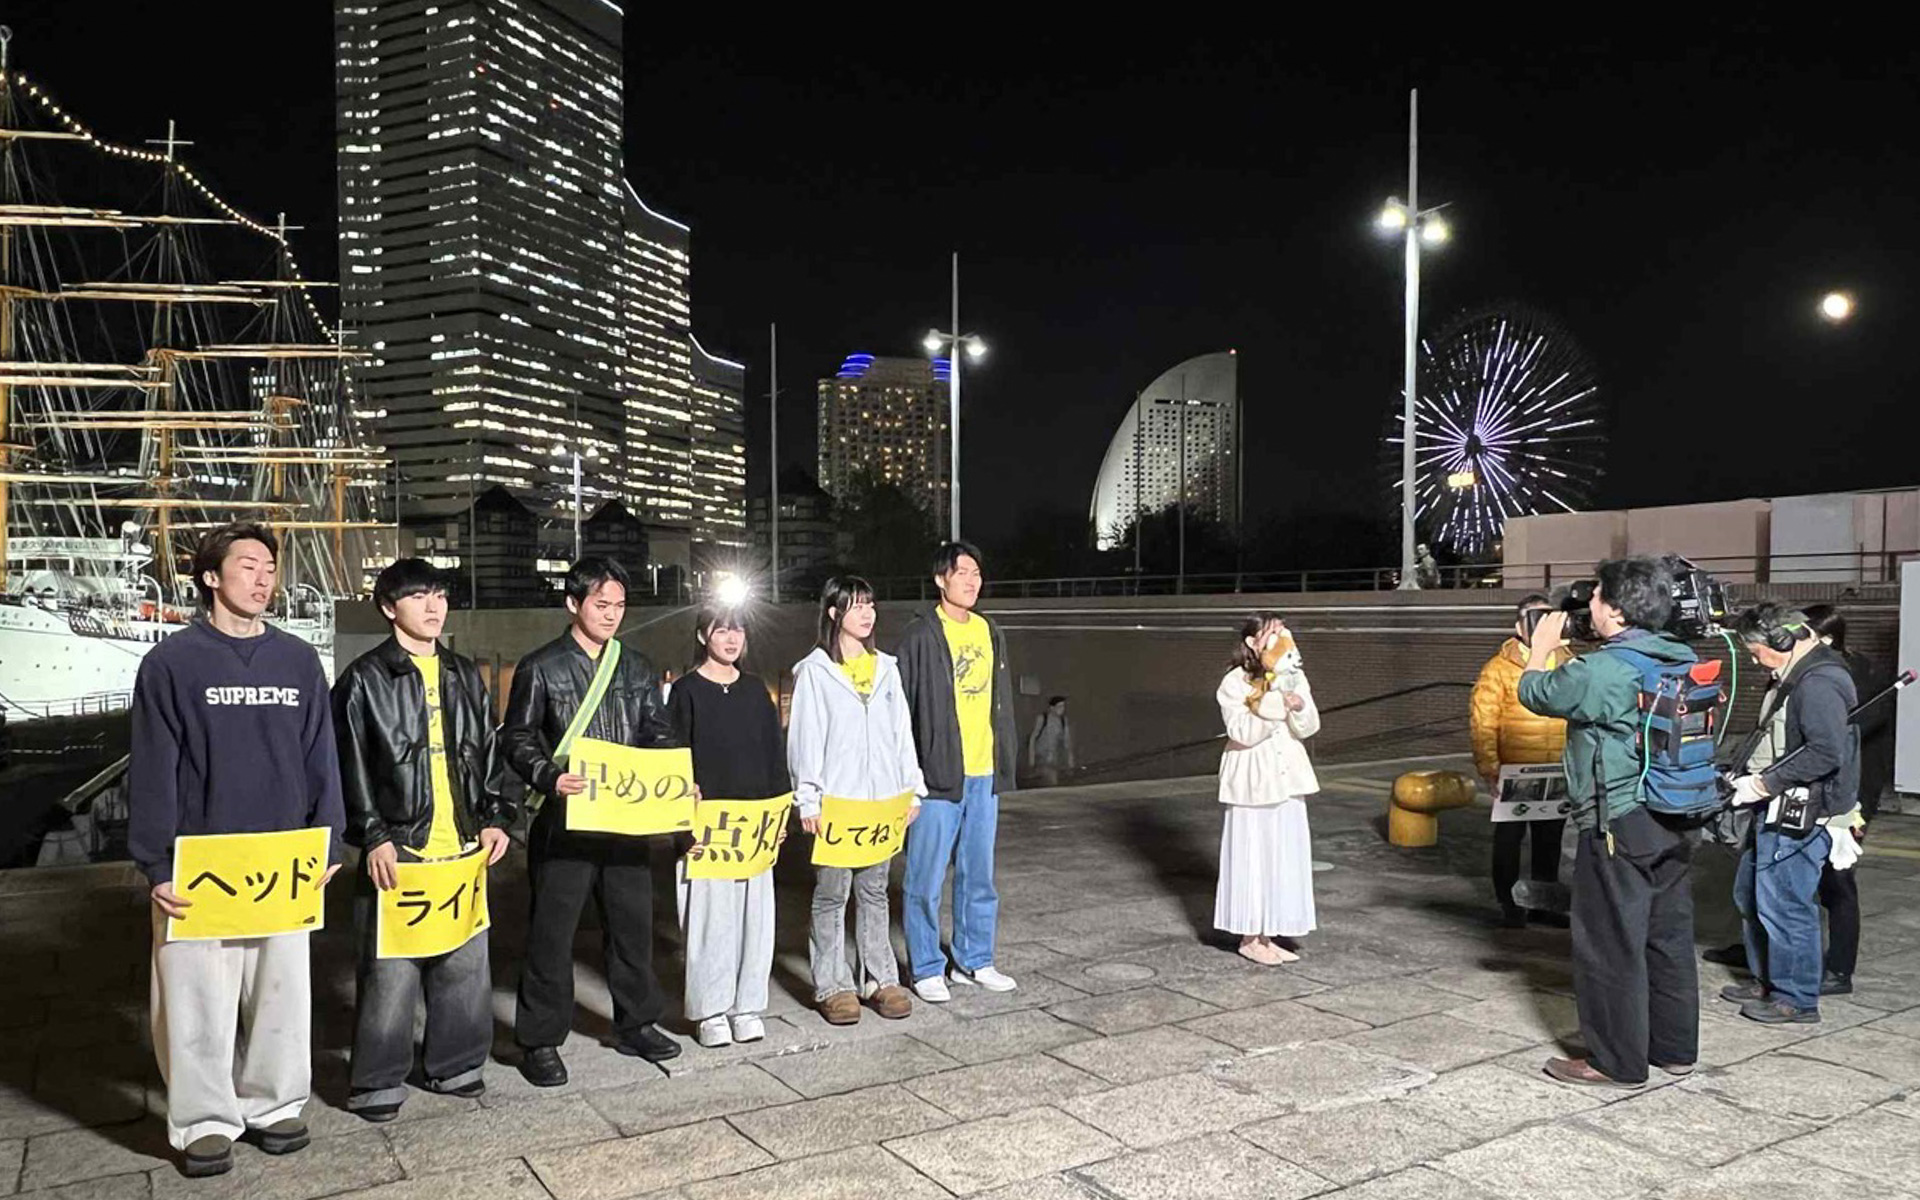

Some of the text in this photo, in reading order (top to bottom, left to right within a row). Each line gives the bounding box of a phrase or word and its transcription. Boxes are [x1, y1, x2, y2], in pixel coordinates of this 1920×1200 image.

[205, 686, 300, 706] SUPREME
[581, 760, 688, 804] 早めの
[693, 804, 790, 862] 点灯
[187, 857, 318, 902] ヘッド
[397, 876, 480, 926] ライト
